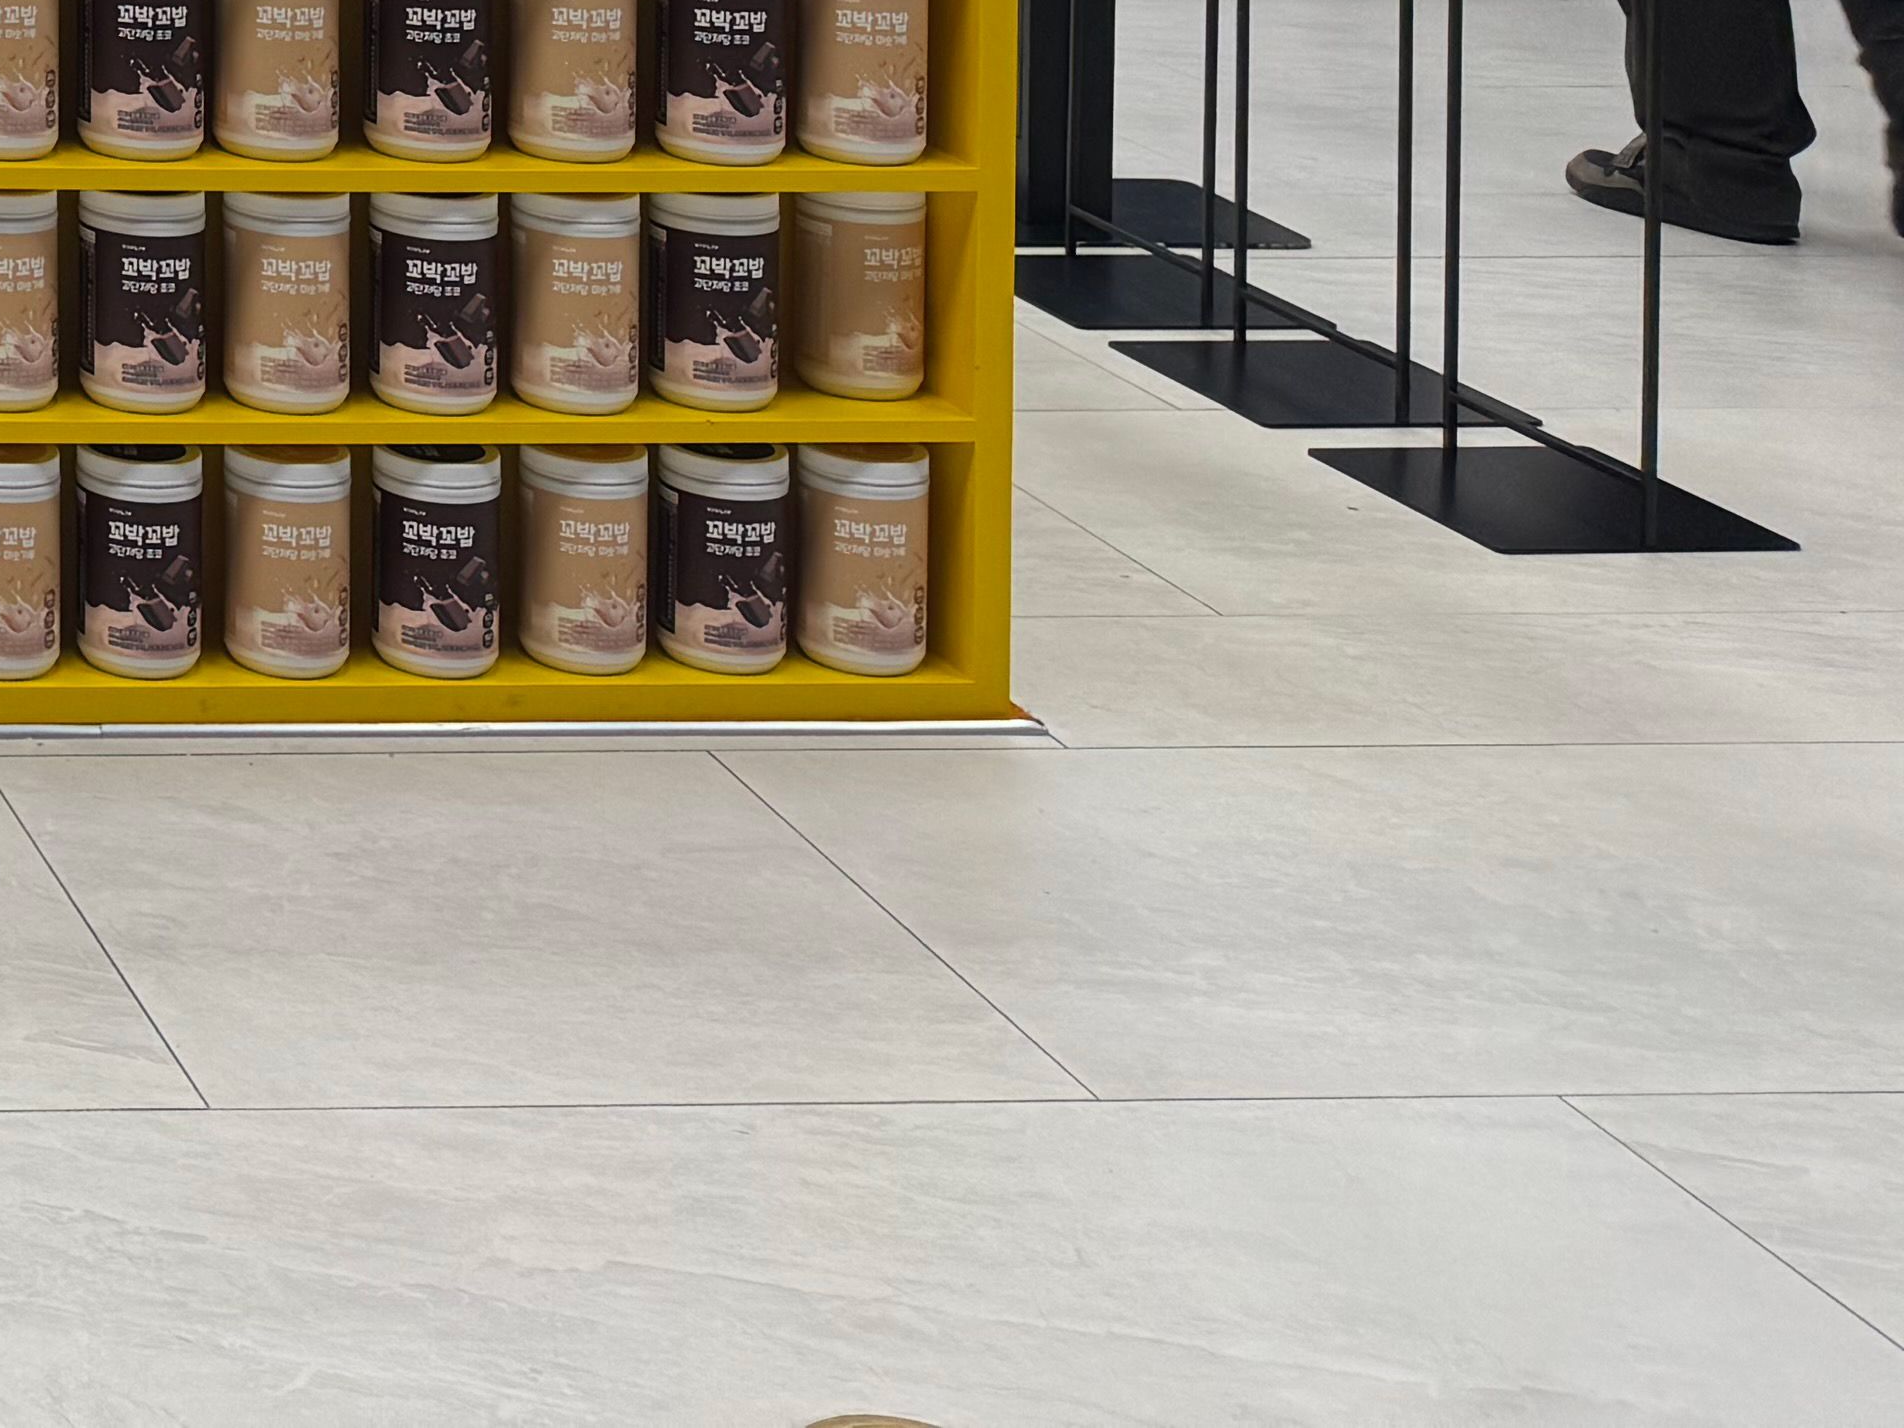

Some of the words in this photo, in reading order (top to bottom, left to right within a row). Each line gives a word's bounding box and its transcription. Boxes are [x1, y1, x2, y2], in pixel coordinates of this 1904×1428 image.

[406, 8, 476, 30] 꼬박꼬밥
[406, 260, 477, 284] 꼬박꼬밥
[262, 524, 331, 547] 꼬박꼬밥
[834, 520, 906, 544] 꼬박꼬밥
